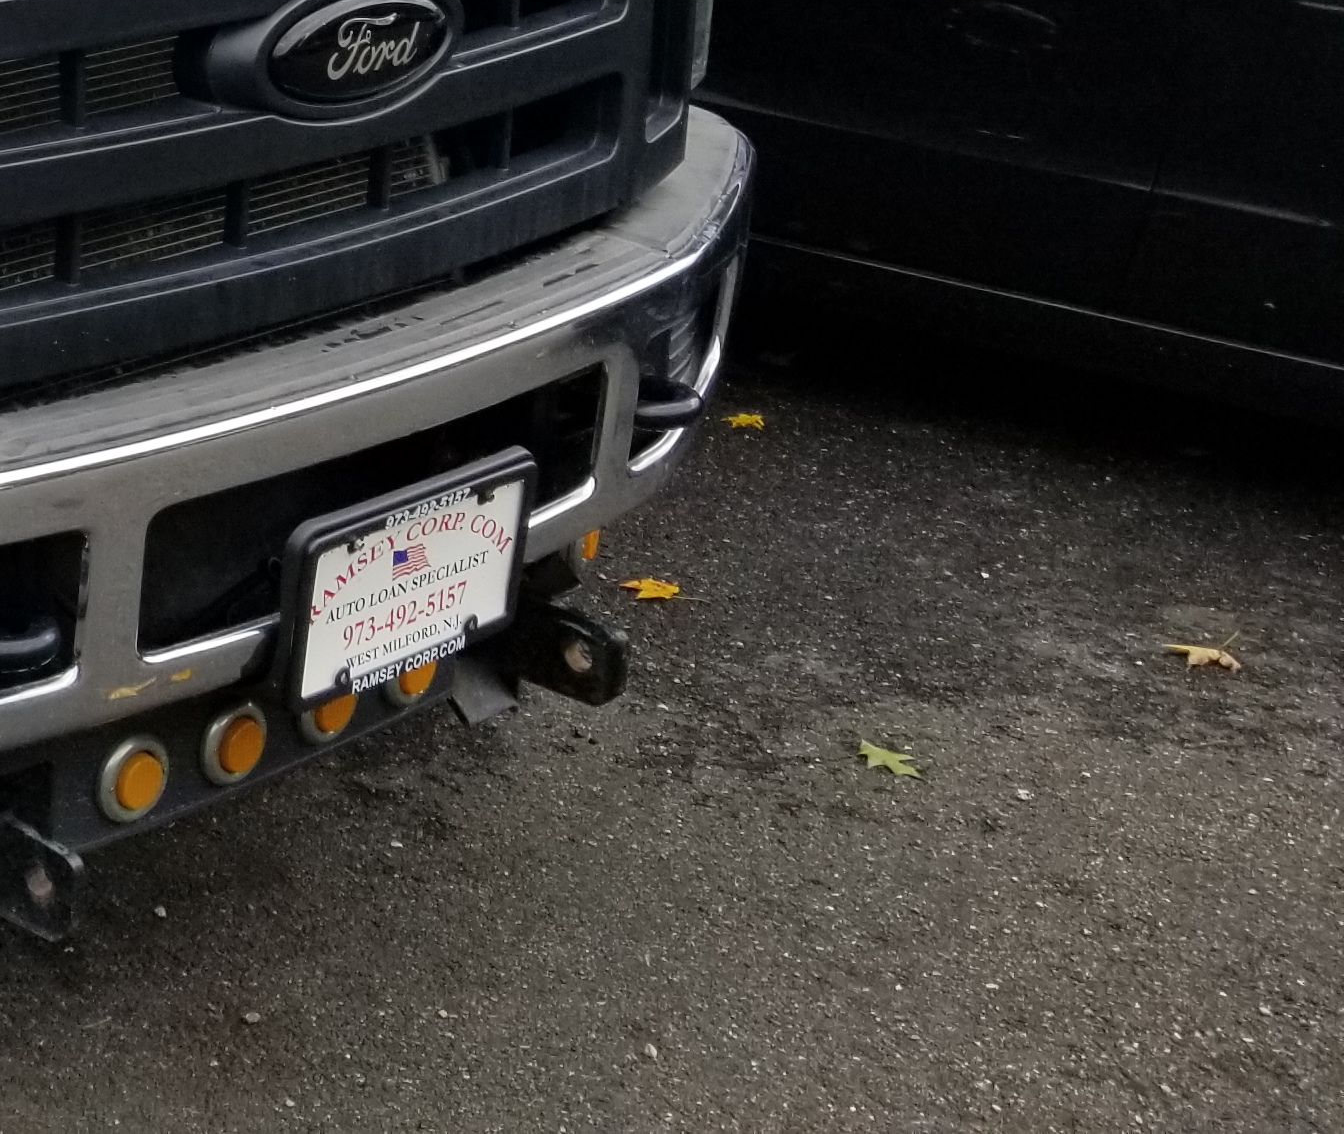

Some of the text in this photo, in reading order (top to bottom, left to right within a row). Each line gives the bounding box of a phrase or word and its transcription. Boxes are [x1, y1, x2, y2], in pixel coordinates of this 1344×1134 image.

[326, 12, 421, 81] Ford
[470, 514, 513, 555] COM
[325, 550, 489, 625] AUTO LOAN SPECIALIST
[343, 580, 467, 651] 973-492-5157
[346, 647, 380, 670] WEST
[382, 623, 440, 656] MILFORD,
[352, 660, 403, 695] RAMSEY
